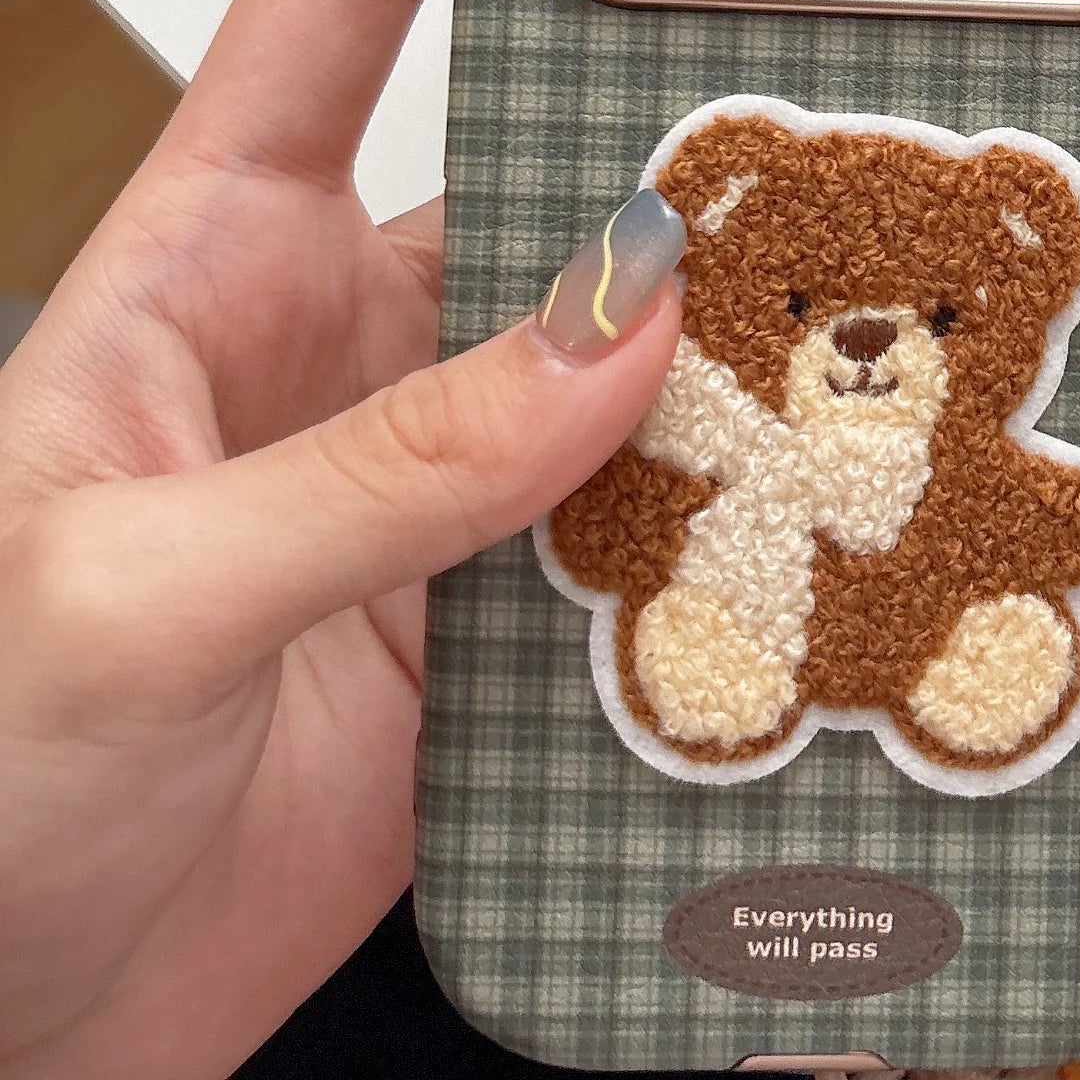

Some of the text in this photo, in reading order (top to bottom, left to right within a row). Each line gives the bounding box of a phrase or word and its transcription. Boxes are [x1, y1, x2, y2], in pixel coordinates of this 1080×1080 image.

[733, 906, 893, 934] Everything
[747, 937, 879, 963] will pass
